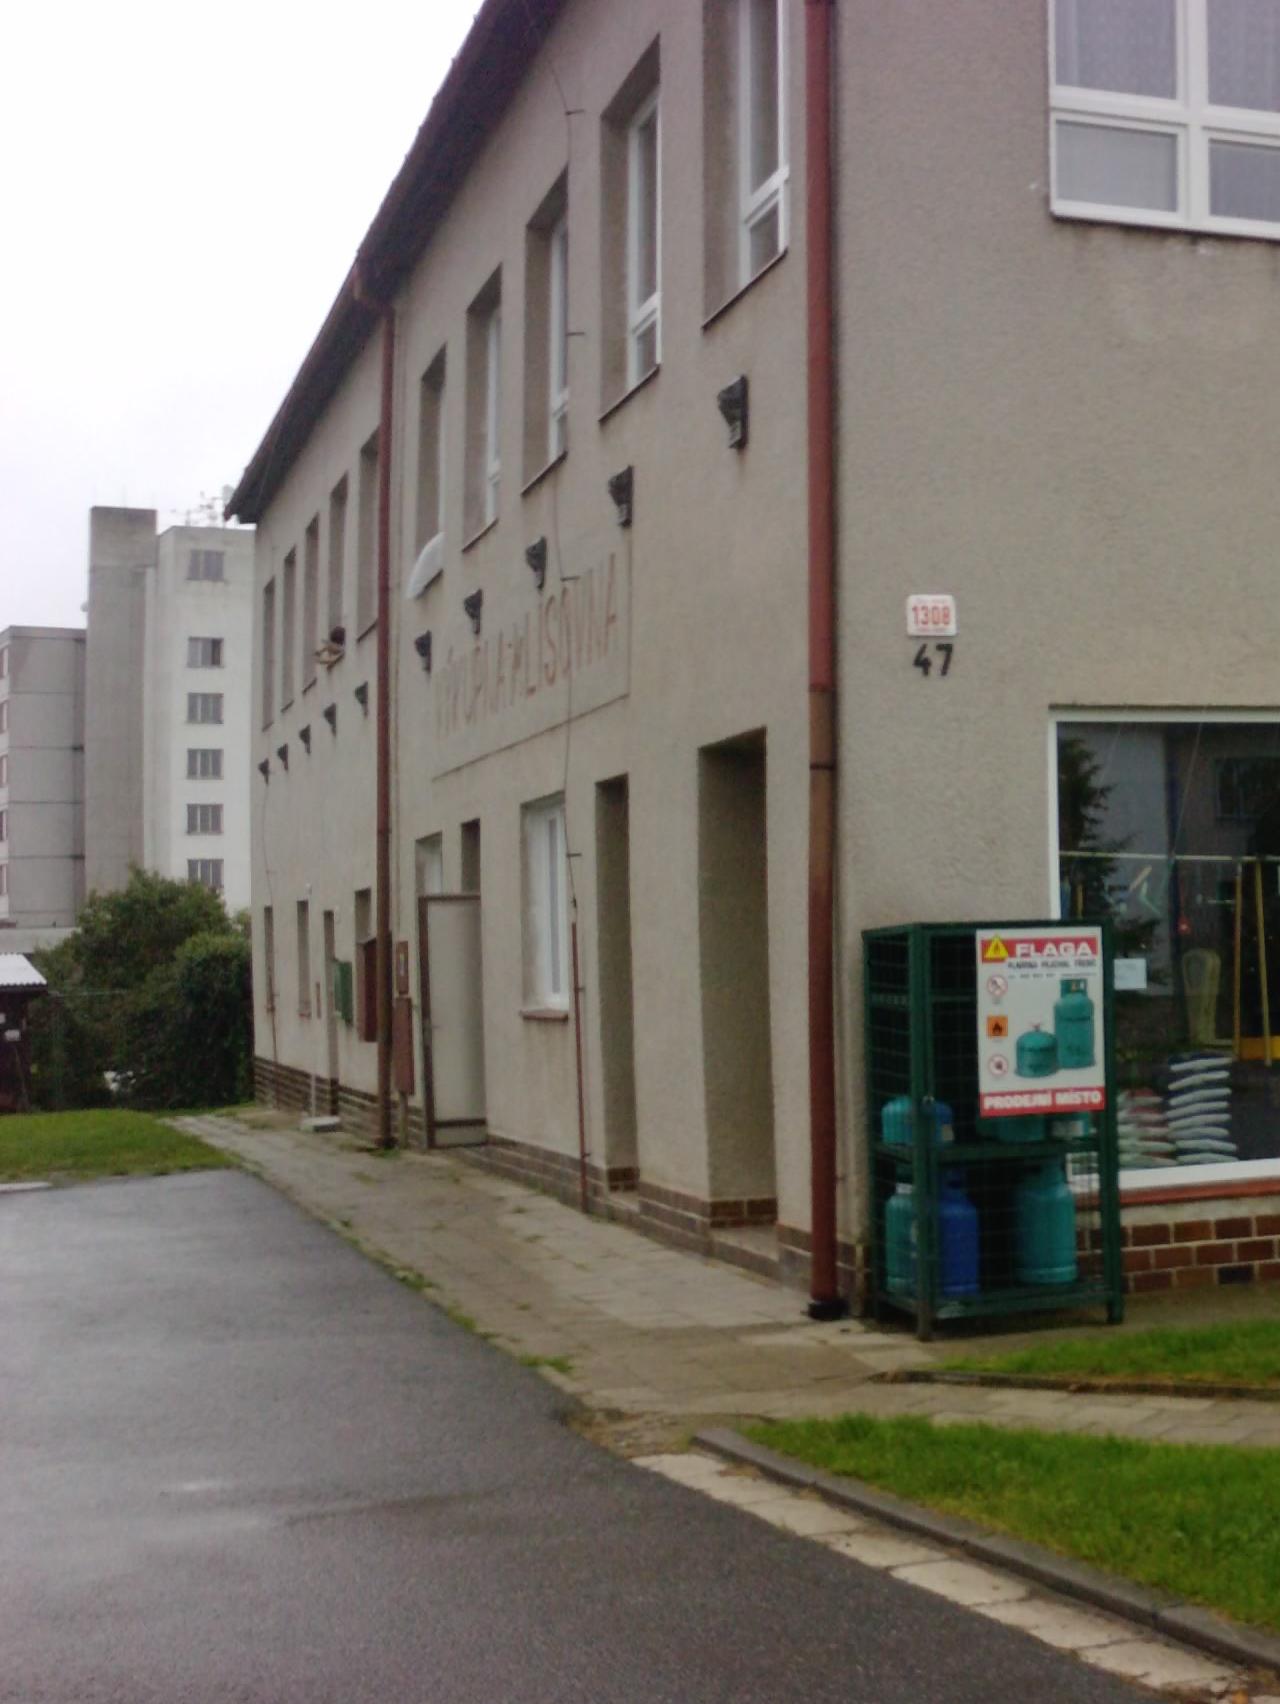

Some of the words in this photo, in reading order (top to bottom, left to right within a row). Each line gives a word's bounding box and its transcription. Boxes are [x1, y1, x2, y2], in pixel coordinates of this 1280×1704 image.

[912, 643, 954, 677] 47
[1015, 941, 1093, 959] FLAGA
[1055, 1090, 1101, 1106] MÍSTO
